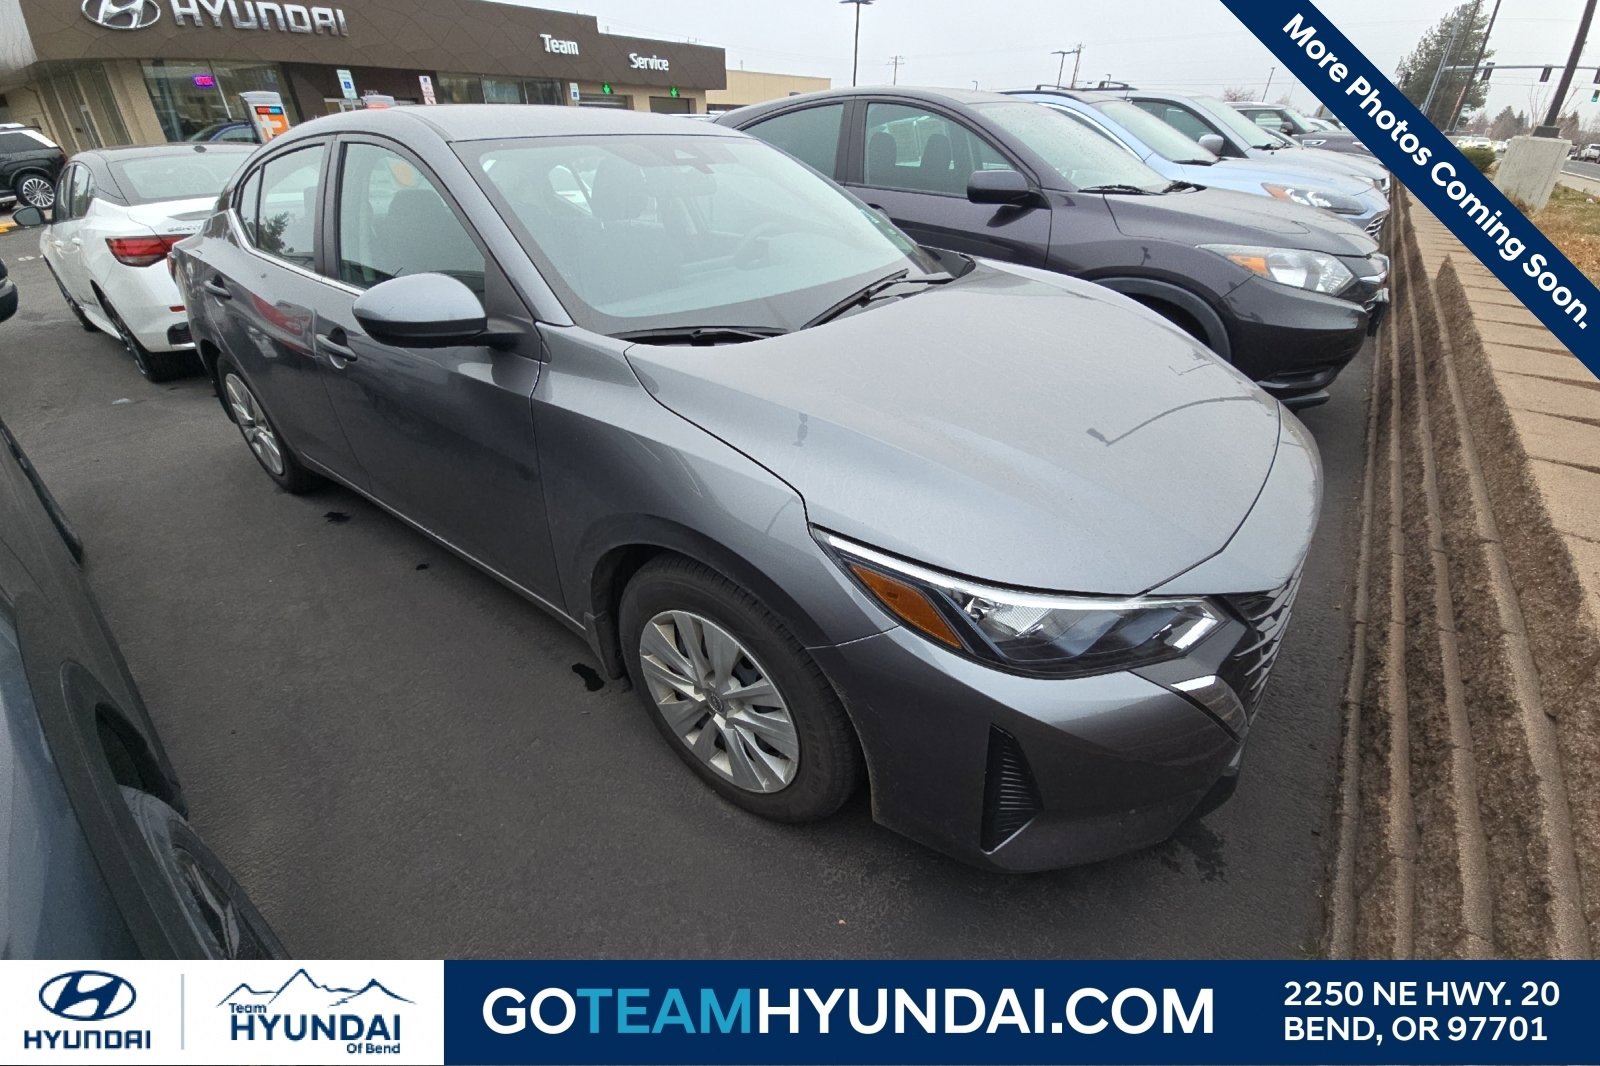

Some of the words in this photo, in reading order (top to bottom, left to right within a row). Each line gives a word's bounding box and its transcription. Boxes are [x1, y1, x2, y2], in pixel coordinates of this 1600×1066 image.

[170, 0, 349, 37] HYUNDAI
[540, 33, 579, 55] Team
[629, 53, 669, 71] Service
